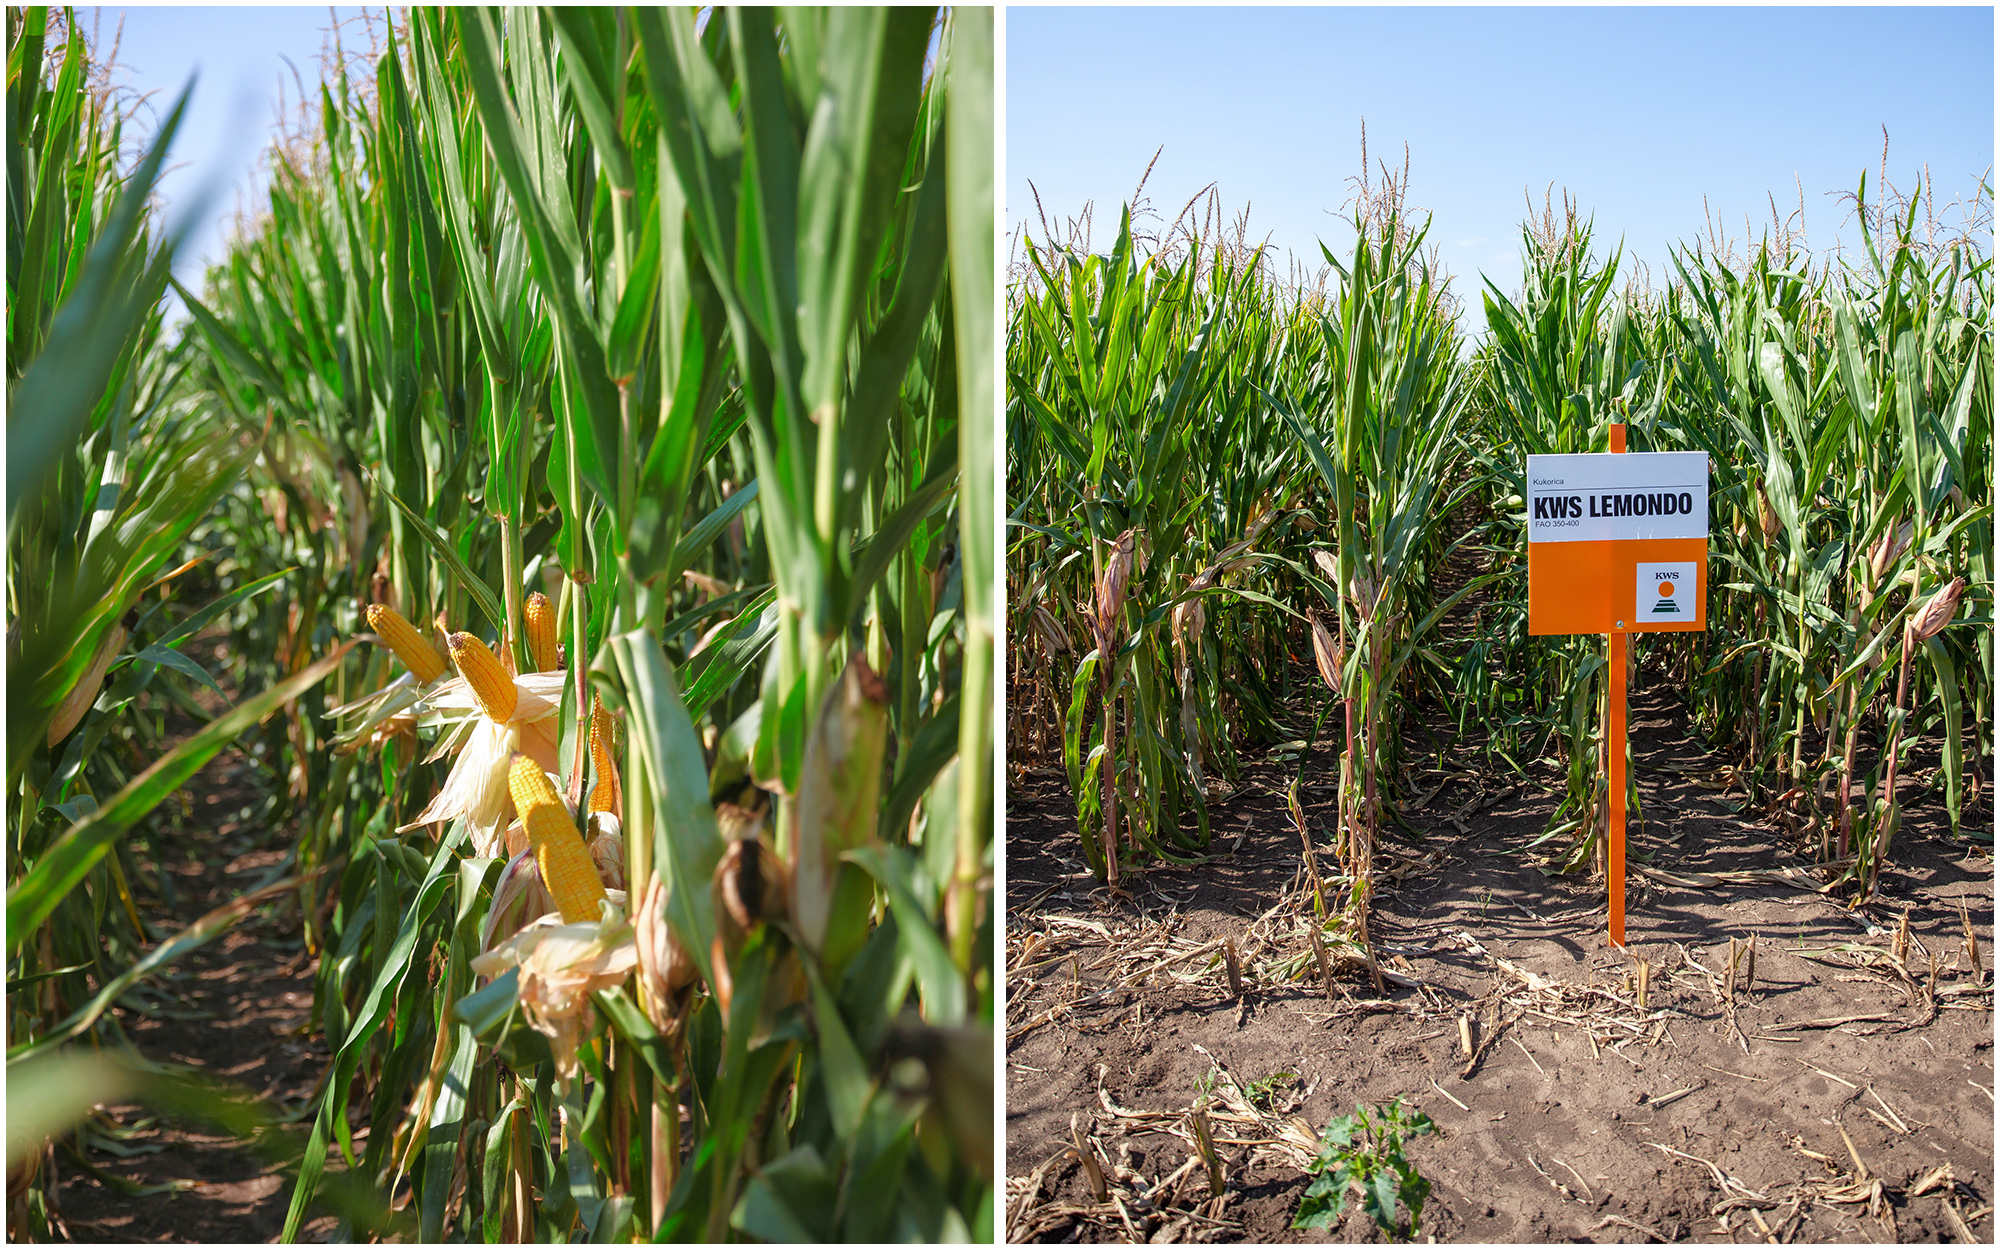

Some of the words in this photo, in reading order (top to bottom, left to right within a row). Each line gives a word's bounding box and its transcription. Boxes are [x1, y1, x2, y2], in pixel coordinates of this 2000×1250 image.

[1533, 478, 1565, 486] Kukorica
[1534, 496, 1582, 519] KWS
[1589, 492, 1693, 518] LEMONDO
[1552, 520, 1580, 528] 350-400
[1655, 572, 1680, 580] KWS
